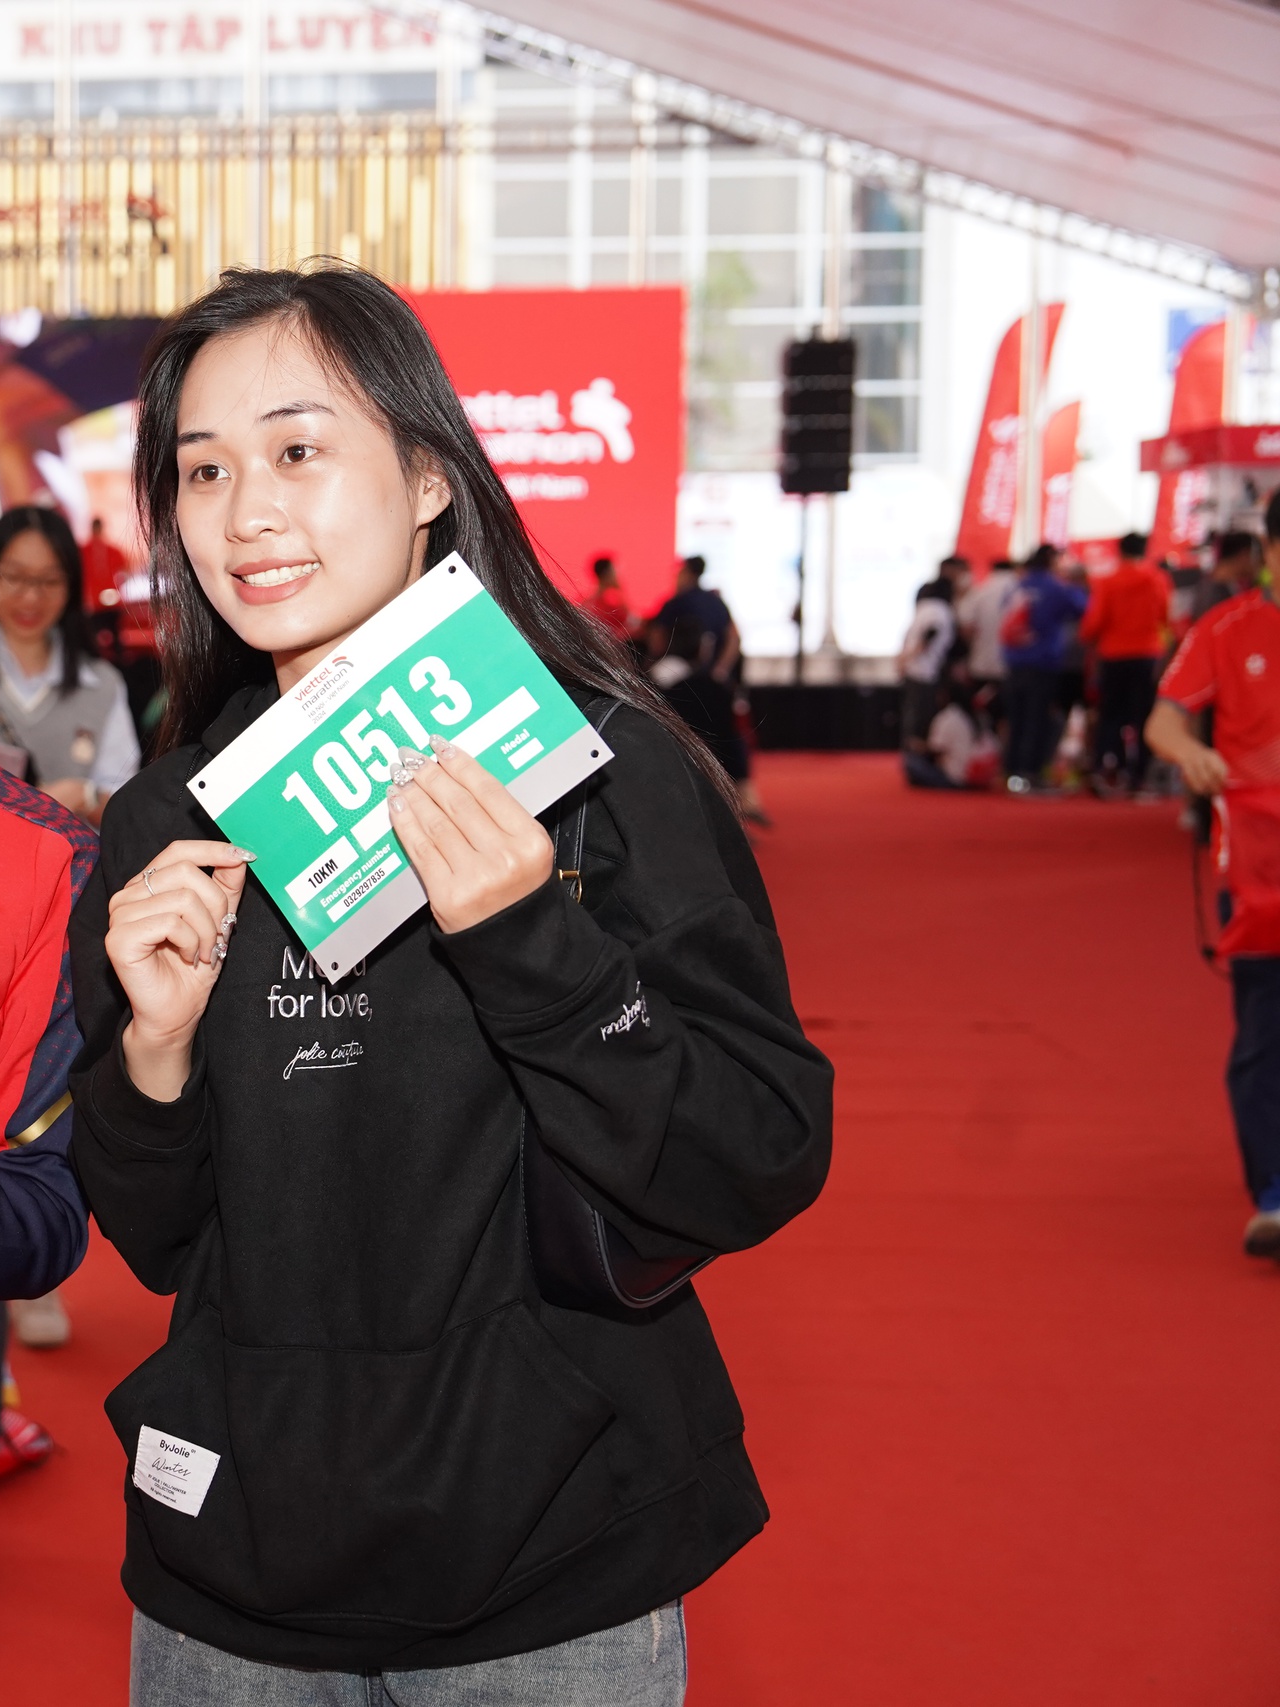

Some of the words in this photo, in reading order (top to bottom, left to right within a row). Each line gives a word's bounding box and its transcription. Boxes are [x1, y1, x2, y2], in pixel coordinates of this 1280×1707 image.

[294, 667, 332, 701] viettel
[301, 668, 348, 711] marathon
[281, 656, 473, 836] 10513
[500, 728, 531, 755] Medal
[308, 858, 339, 888] 10KM
[320, 868, 364, 909] Emergency
[361, 843, 391, 873] number
[343, 867, 386, 908] 0329297835
[267, 984, 314, 1018] for
[321, 984, 373, 1022] love,
